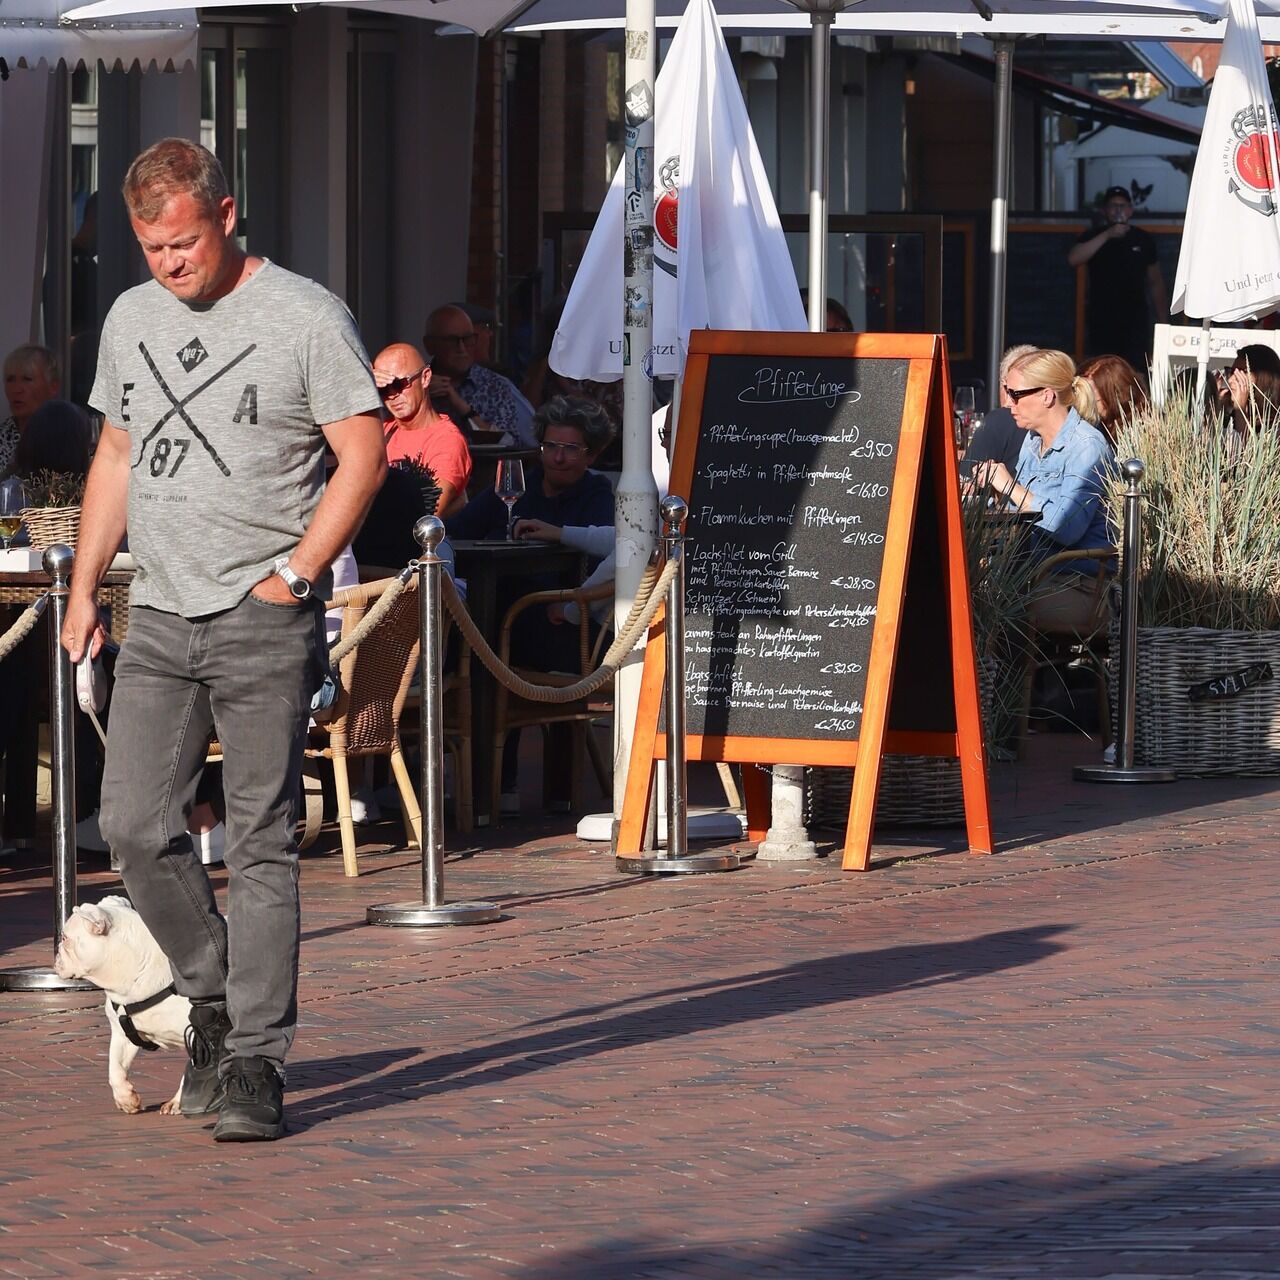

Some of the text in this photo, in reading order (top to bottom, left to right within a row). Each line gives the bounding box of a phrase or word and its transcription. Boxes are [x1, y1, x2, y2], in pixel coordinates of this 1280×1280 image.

[754, 367, 847, 408] Pfifferlinge
[150, 438, 191, 479] 87
[850, 440, 894, 459] €9,50
[703, 463, 751, 490] Spaghetti
[757, 465, 767, 480] in
[847, 482, 889, 499] €16,80
[700, 504, 774, 526] Flammkuchen
[776, 504, 796, 526] mit
[842, 532, 885, 546] €14,50
[748, 550, 771, 561] vom
[771, 541, 798, 563] Grill
[689, 573, 709, 587] und
[830, 576, 876, 591] €28,50
[783, 603, 801, 617] und
[685, 621, 736, 641] ammsteak
[737, 630, 751, 640] an
[685, 661, 744, 684] tbarschfilet
[1208, 672, 1249, 696] SYLT
